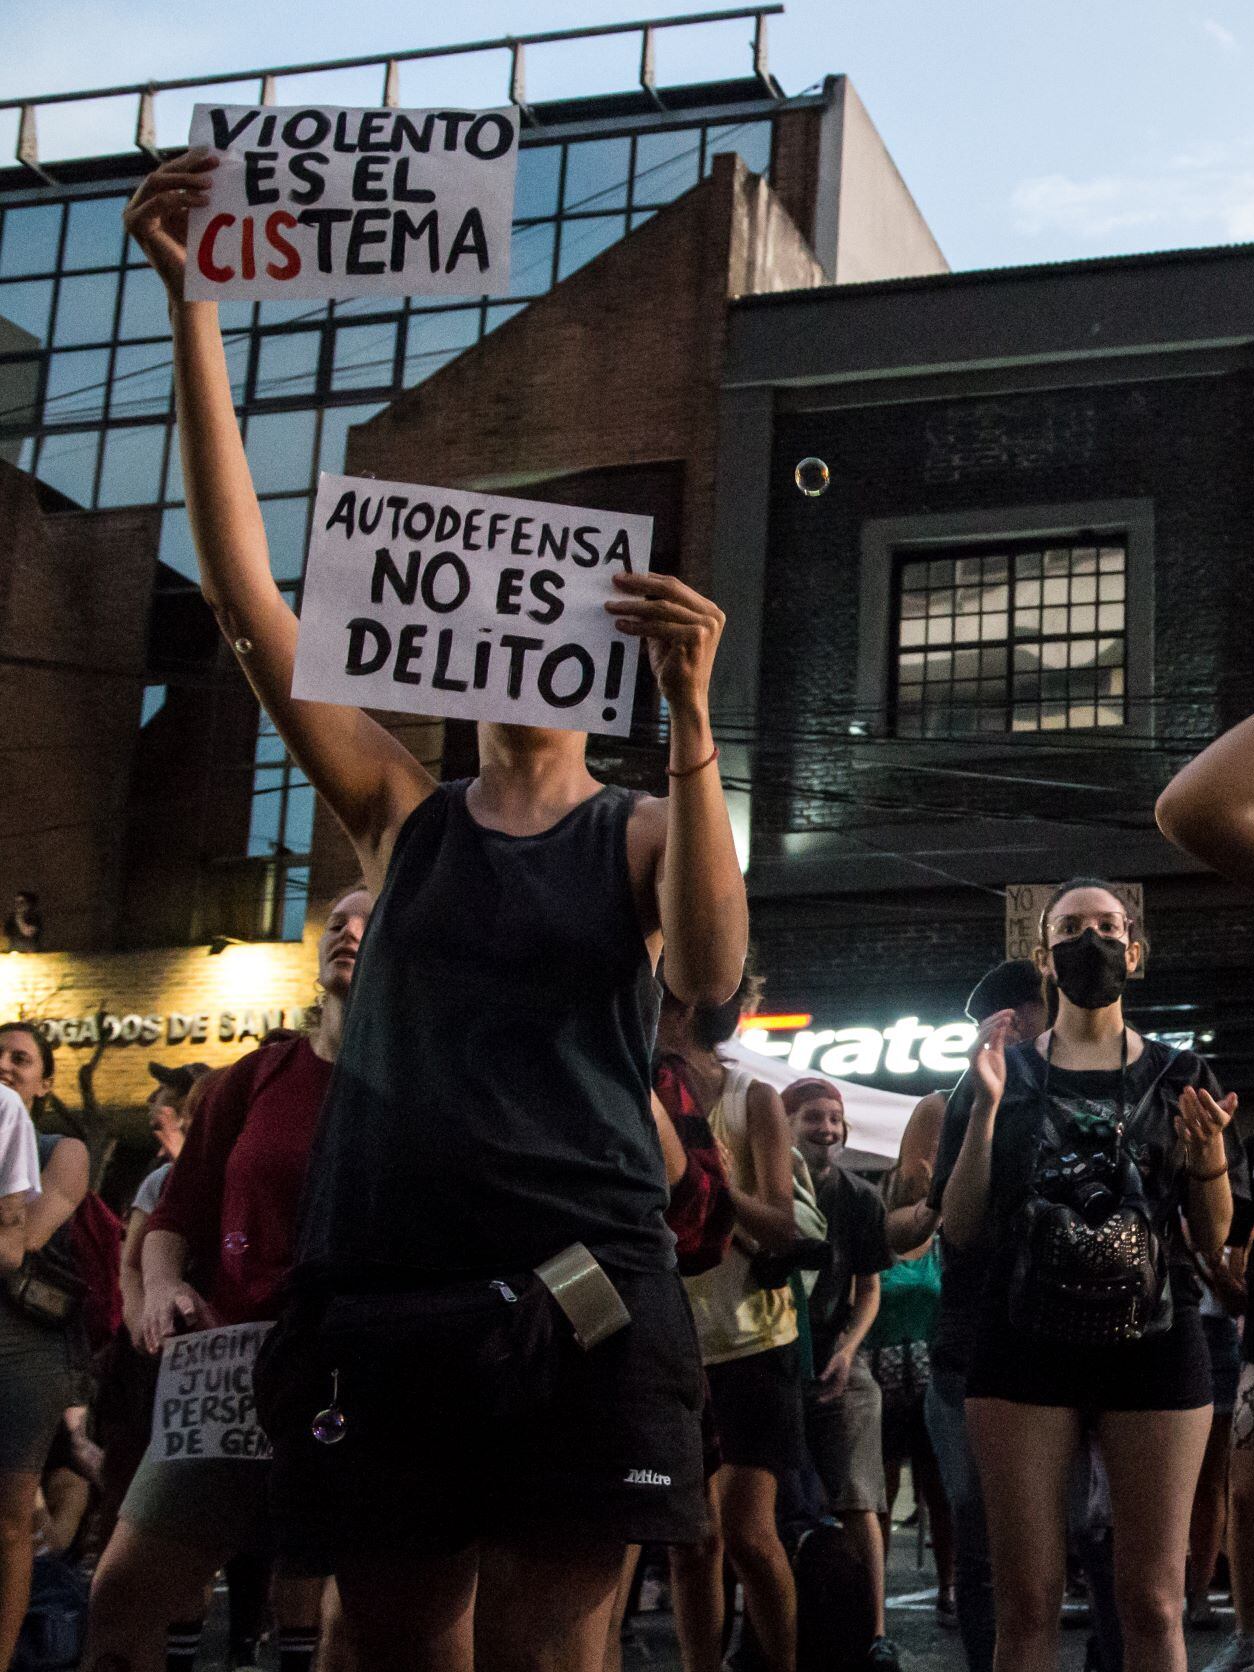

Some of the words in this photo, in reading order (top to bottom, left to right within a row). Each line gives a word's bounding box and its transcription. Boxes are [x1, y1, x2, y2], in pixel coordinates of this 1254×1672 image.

[209, 109, 514, 160] VIOLENTO
[244, 151, 330, 205] ES
[352, 155, 436, 203] EL
[197, 207, 490, 283] CISTEMA
[326, 490, 633, 574] AUTODEFENSA
[371, 547, 471, 614] NO
[496, 567, 566, 625] ES
[39, 1014, 160, 1044] OGADOS
[167, 1012, 208, 1043] DE
[178, 1365, 251, 1395] JUIC
[162, 1394, 256, 1429] PERSP
[164, 1428, 203, 1457] DE
[623, 1468, 672, 1486] Mitre
